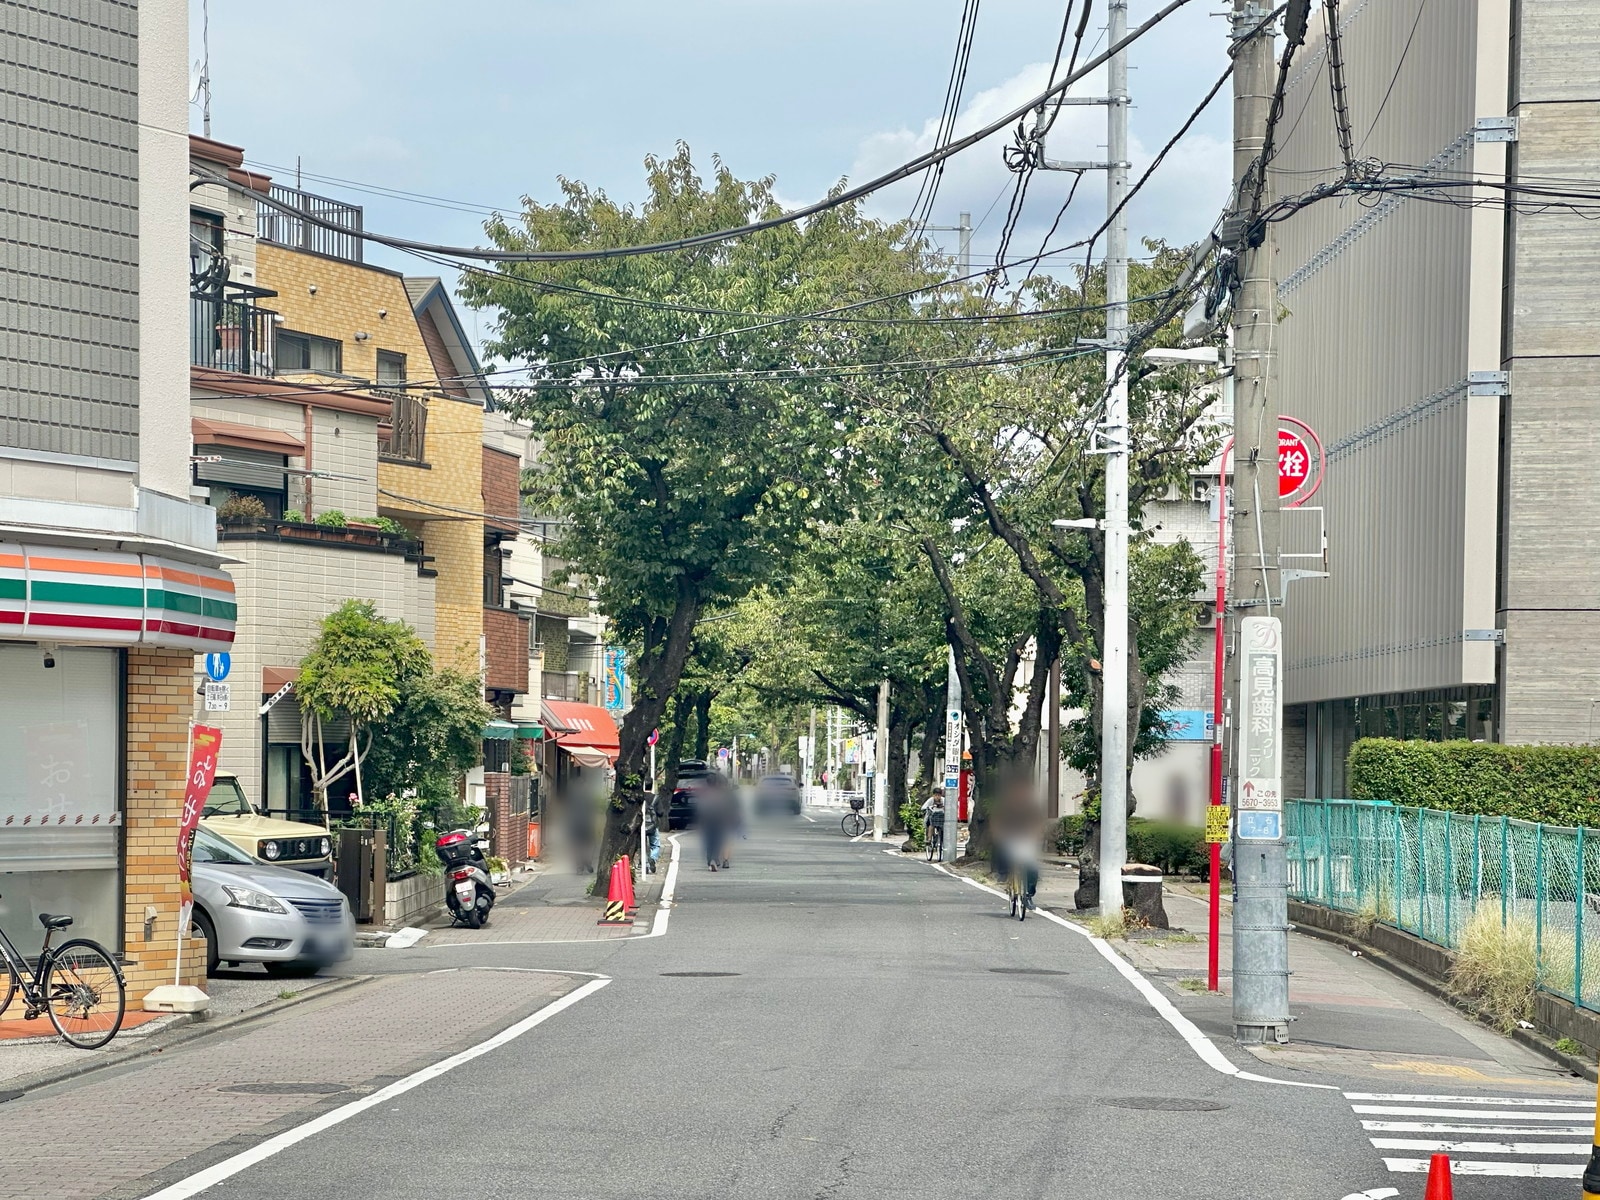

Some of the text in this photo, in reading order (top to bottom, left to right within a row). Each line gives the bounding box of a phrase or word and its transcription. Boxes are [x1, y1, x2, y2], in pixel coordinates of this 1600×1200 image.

[1251, 655, 1274, 737] 高見歯科
[1256, 790, 1277, 798] この先
[1242, 798, 1278, 807] 5670-3953
